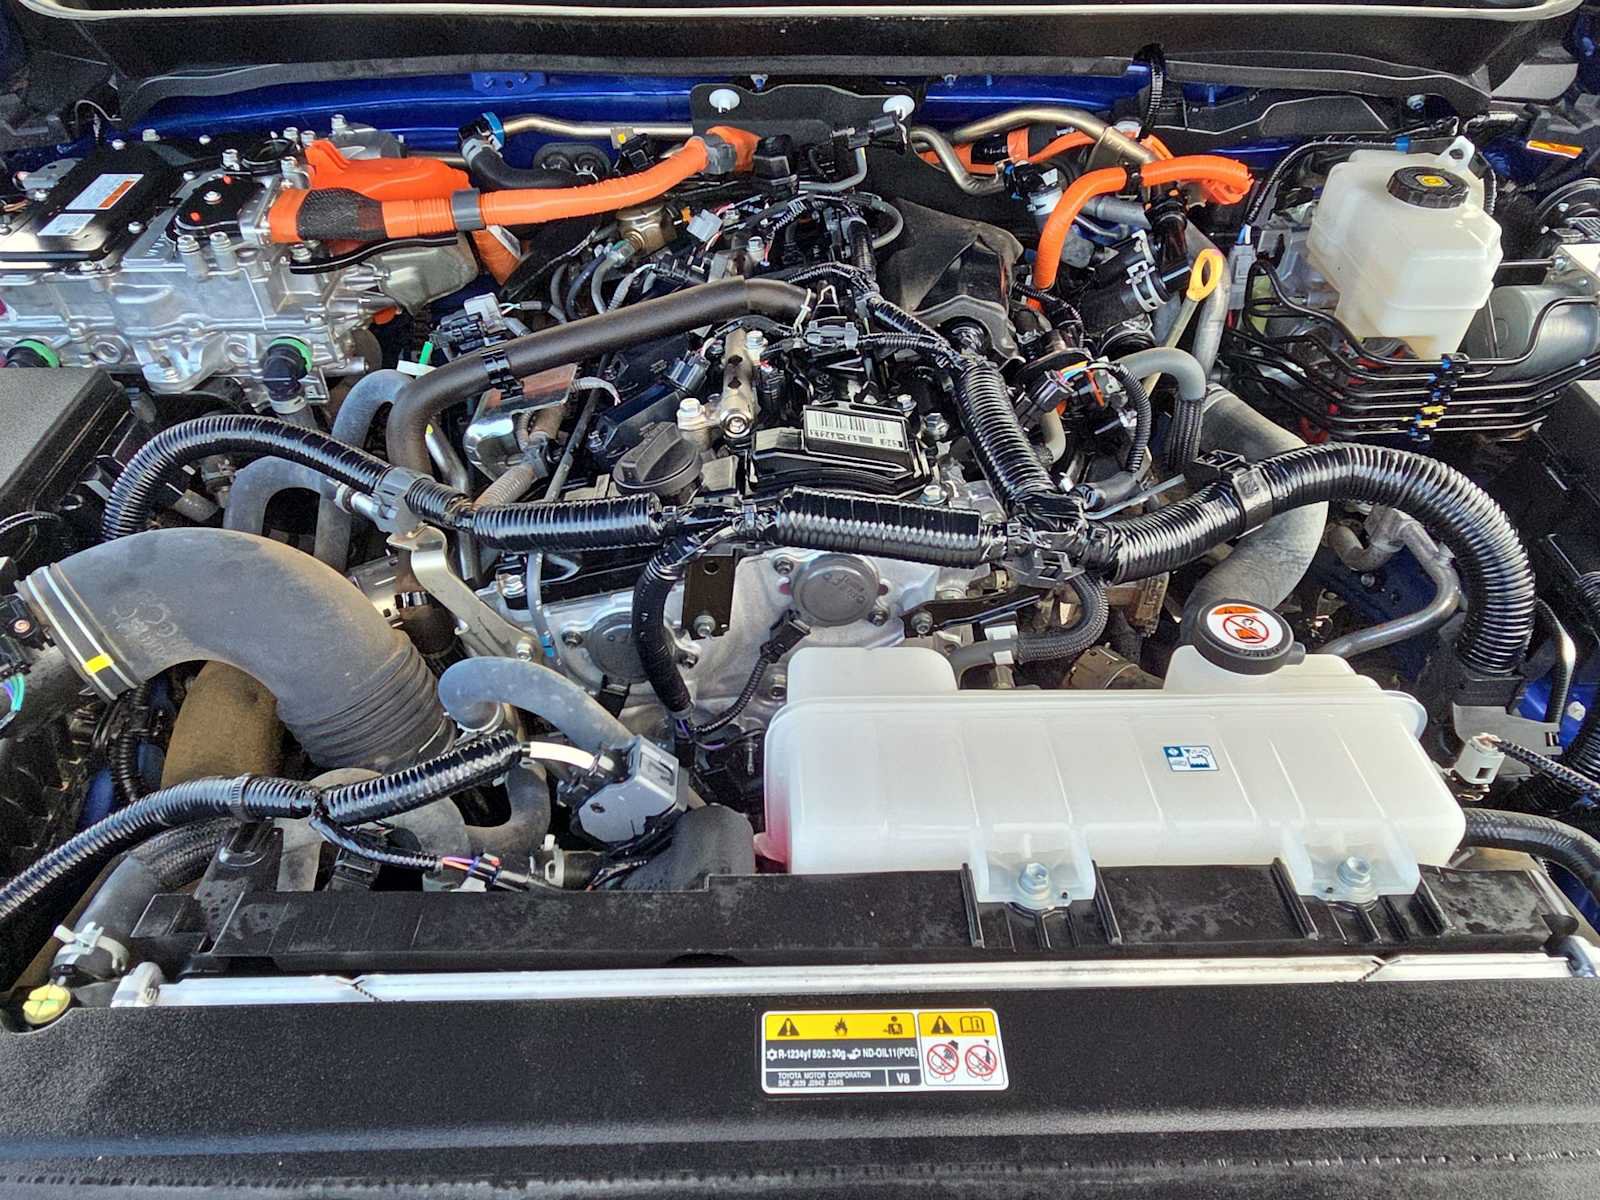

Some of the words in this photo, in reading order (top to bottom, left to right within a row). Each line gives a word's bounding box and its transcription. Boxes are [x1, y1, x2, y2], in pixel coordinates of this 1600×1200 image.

[778, 1048, 811, 1061] R-1234yf
[778, 1072, 802, 1080] TOYOTA
[828, 1071, 872, 1079] CORPORATION
[896, 1072, 911, 1084] V8
